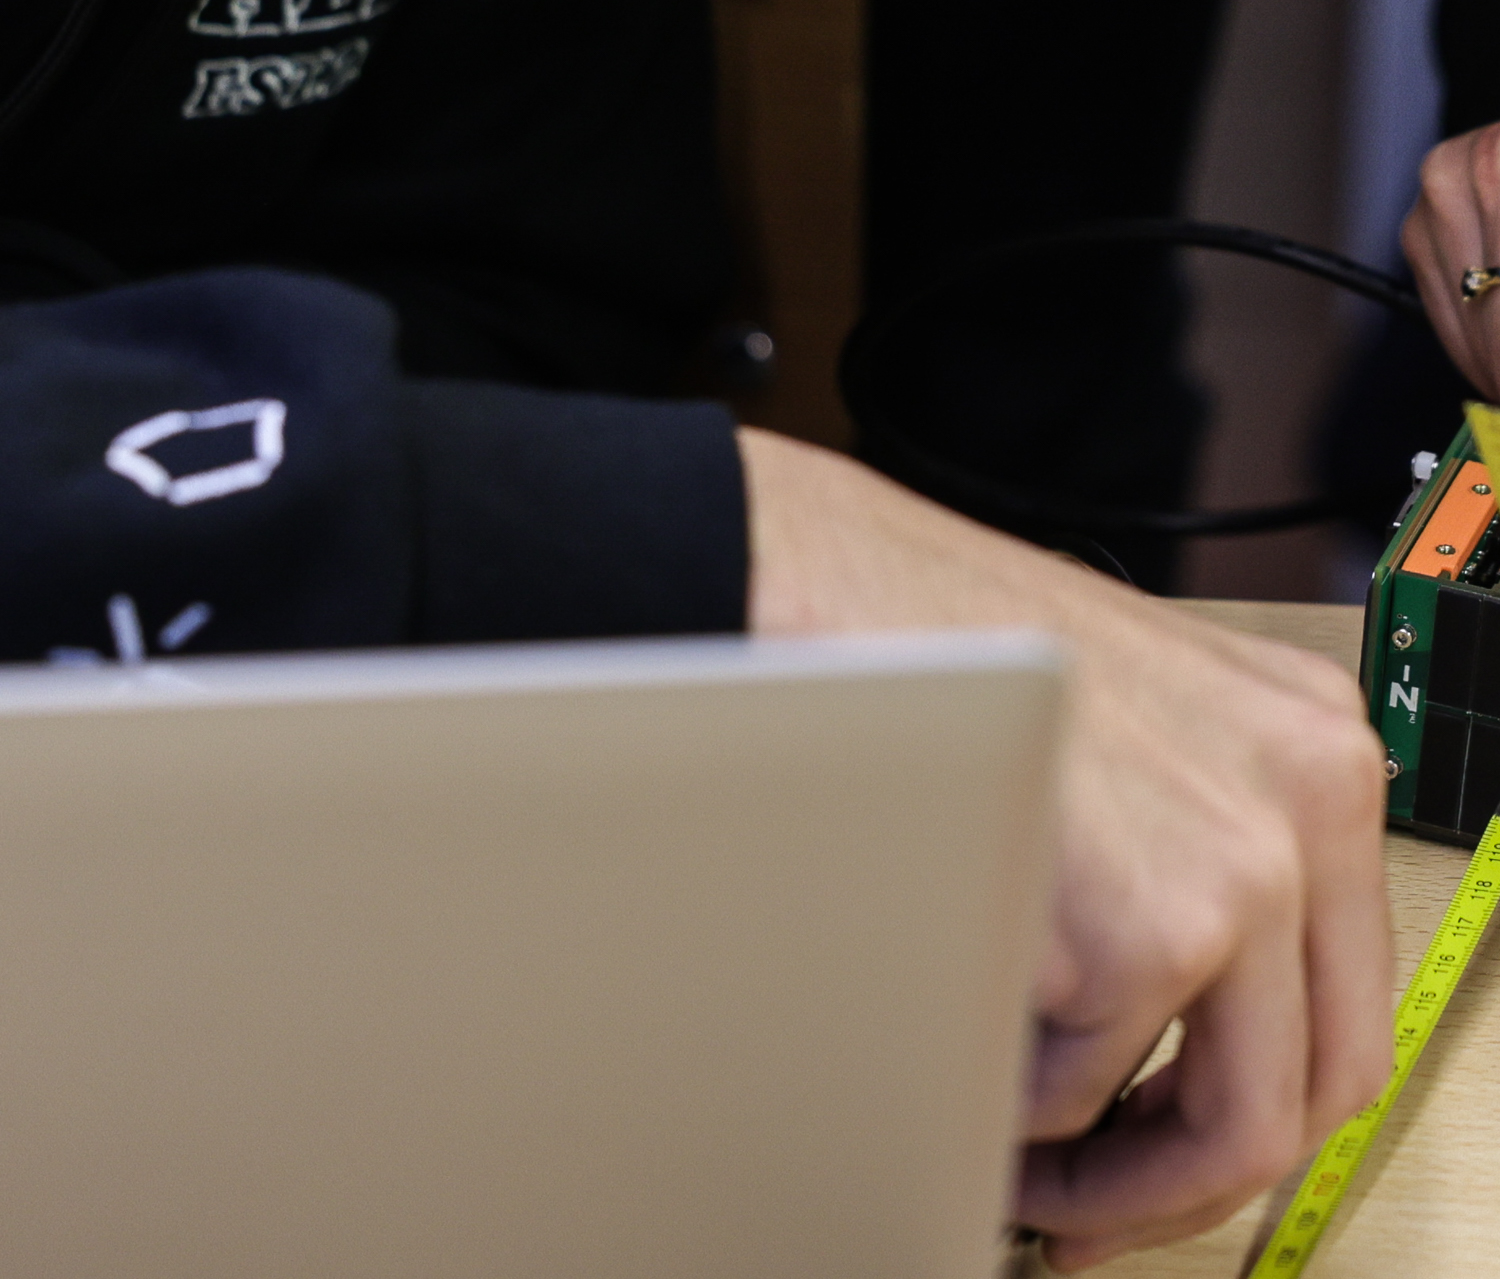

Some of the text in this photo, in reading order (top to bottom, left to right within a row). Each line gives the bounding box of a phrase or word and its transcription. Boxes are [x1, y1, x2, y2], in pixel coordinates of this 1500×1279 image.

[1470, 879, 1493, 900] 118
[1452, 916, 1474, 938] 117
[1433, 953, 1456, 974] 116
[1414, 990, 1437, 1011] 115
